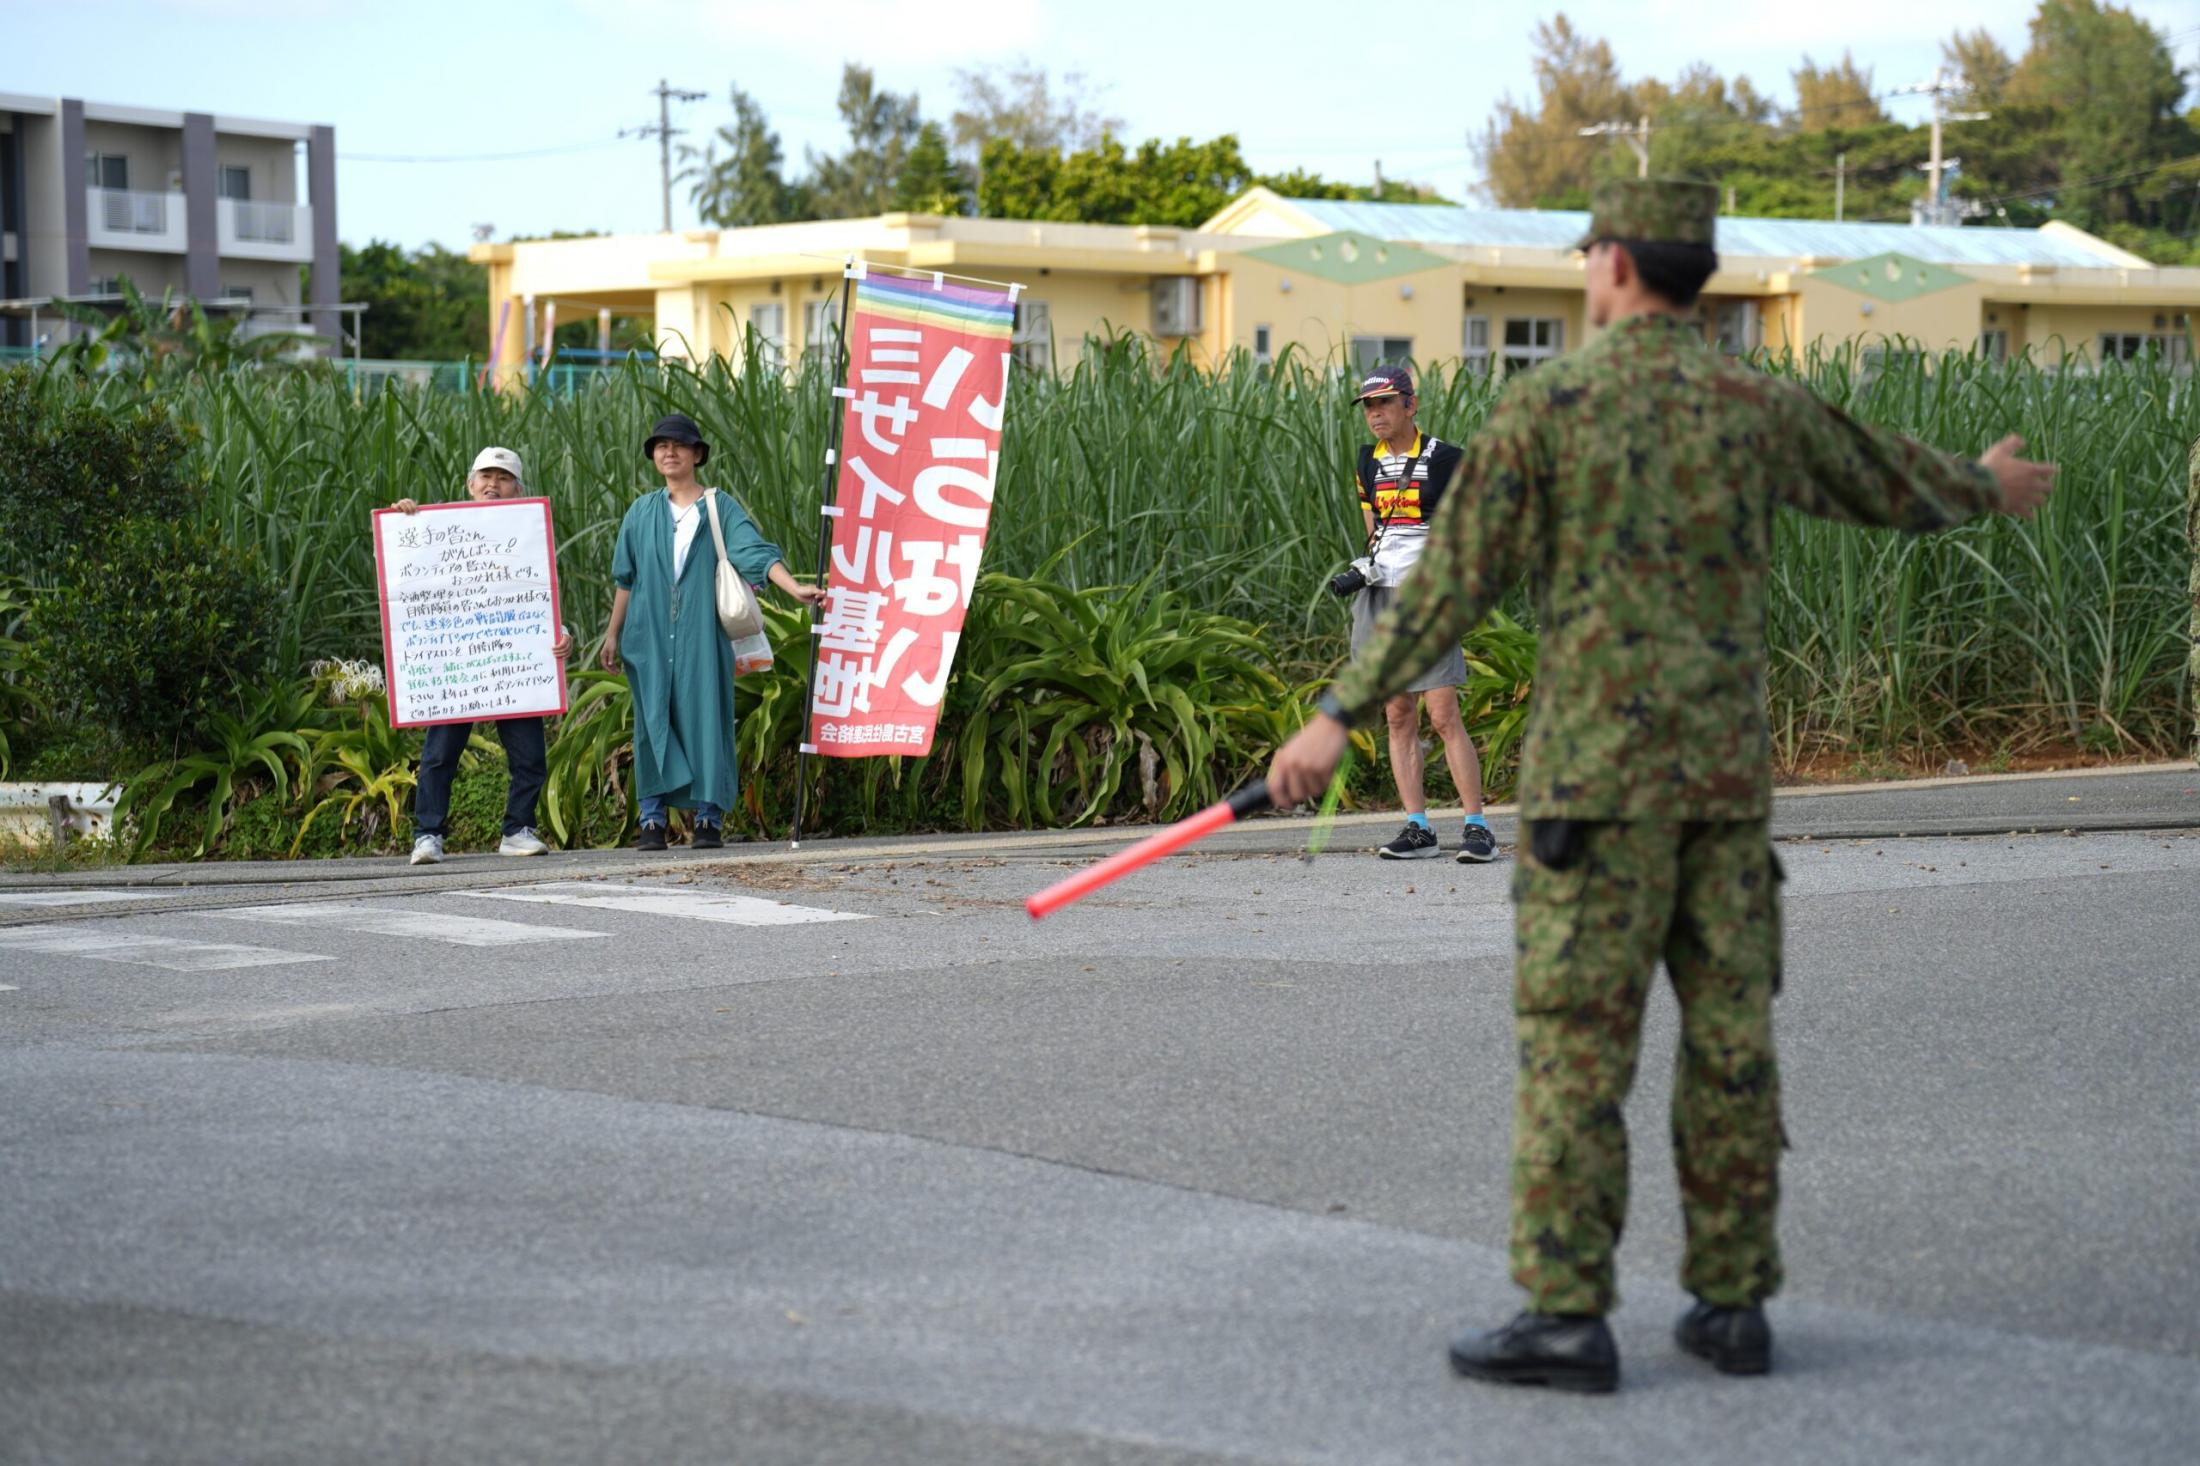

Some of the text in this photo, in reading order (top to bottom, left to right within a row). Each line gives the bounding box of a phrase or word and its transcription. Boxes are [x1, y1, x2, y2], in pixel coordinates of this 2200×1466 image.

[398, 523, 486, 548] 選手の皆さん
